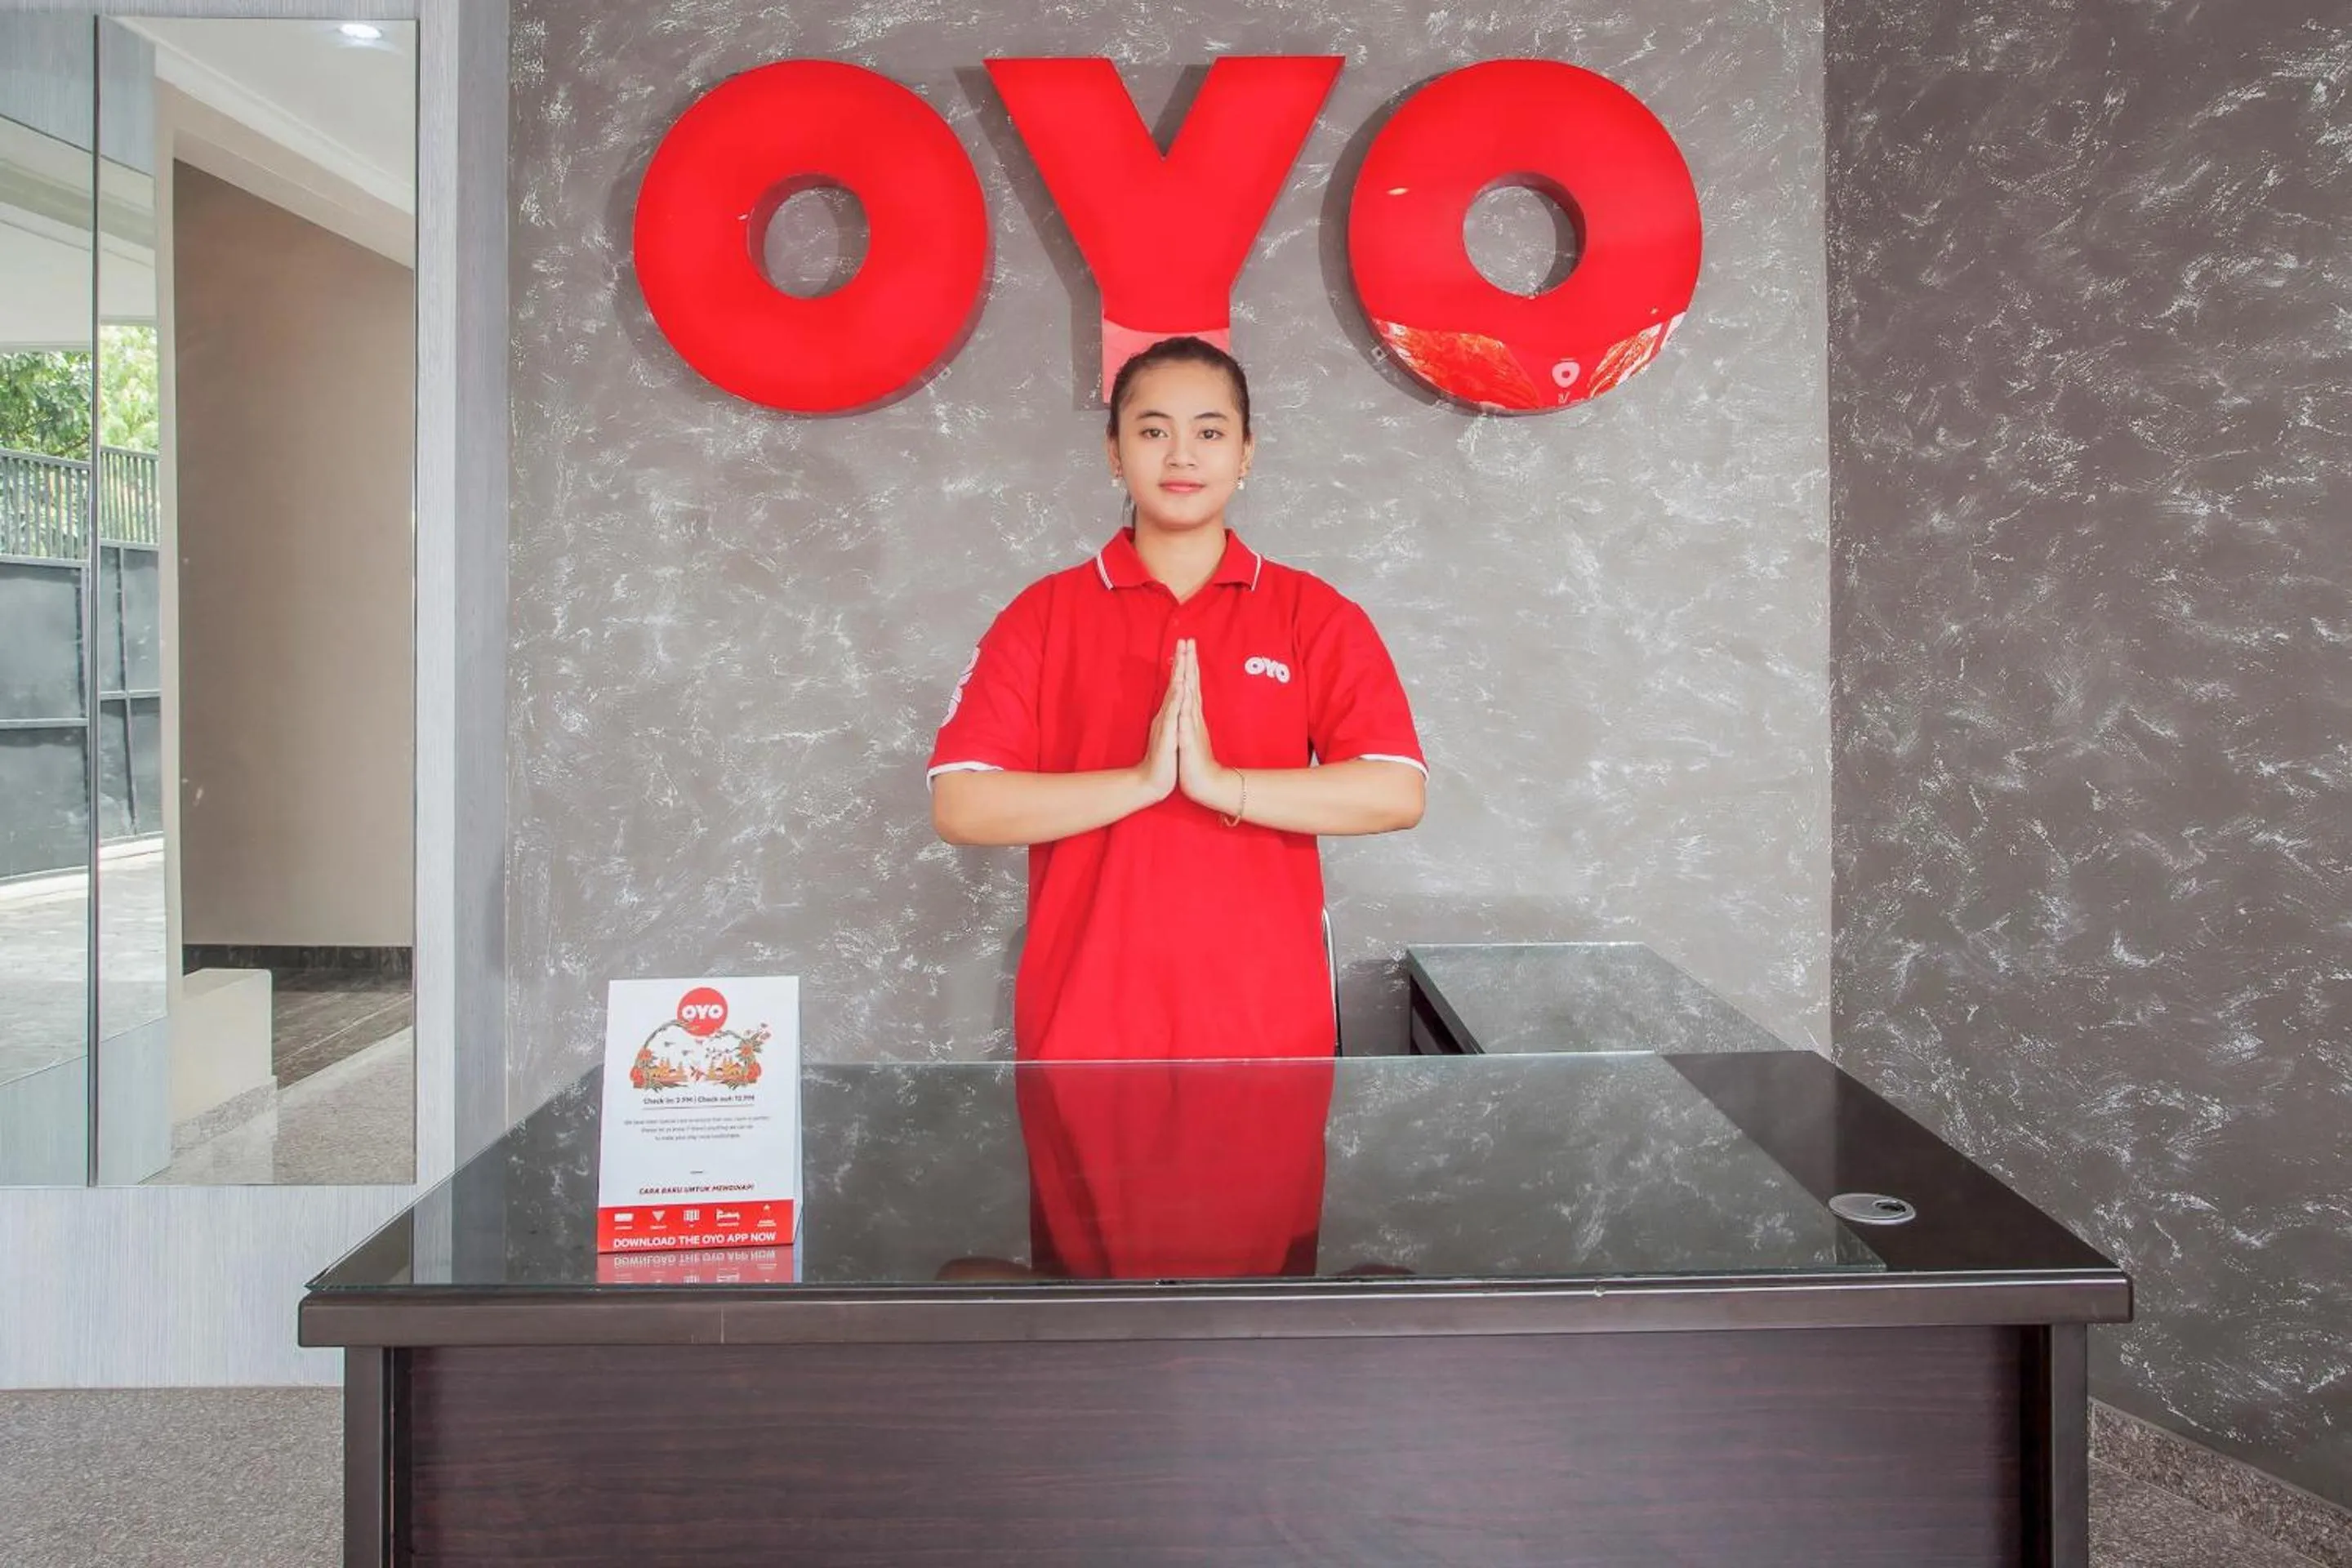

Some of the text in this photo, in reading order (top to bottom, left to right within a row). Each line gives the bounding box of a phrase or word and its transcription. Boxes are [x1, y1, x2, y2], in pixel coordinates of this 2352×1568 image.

[634, 56, 1704, 415] OYO
[1245, 656, 1290, 684] OYO
[681, 1004, 724, 1021] OYO
[697, 1095, 718, 1103] Check
[614, 1232, 777, 1248] DOWNLOAD THE OYO APP NOW
